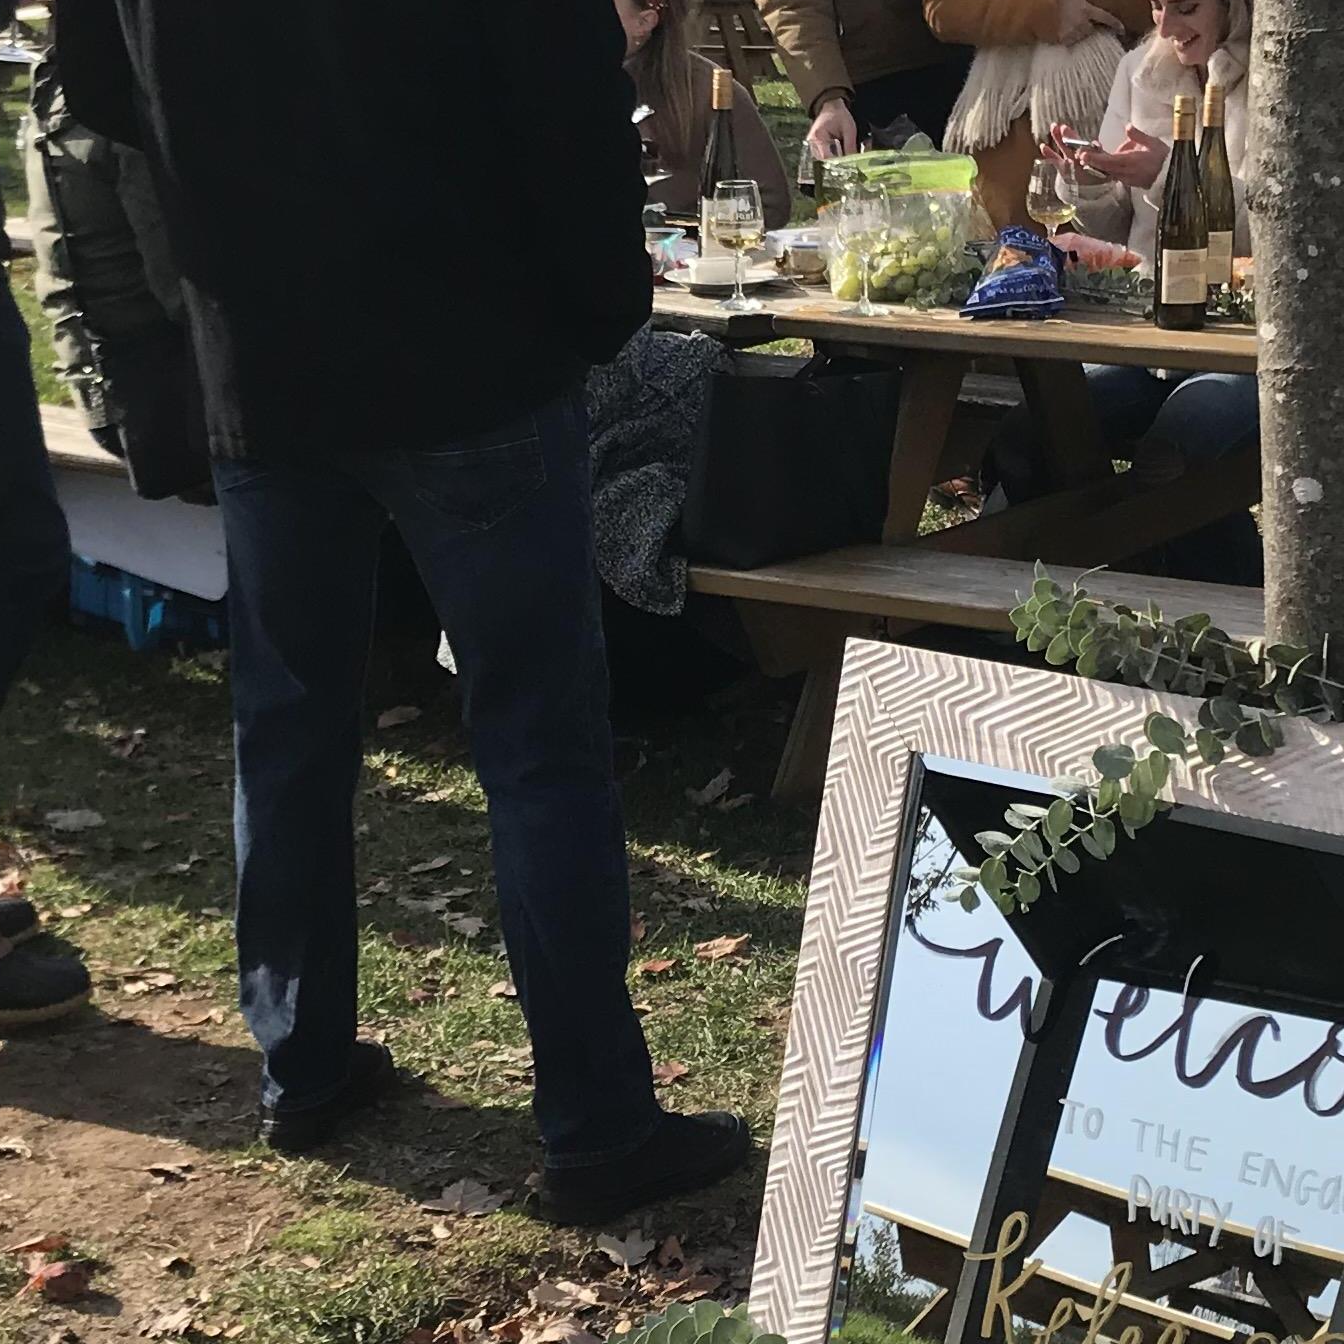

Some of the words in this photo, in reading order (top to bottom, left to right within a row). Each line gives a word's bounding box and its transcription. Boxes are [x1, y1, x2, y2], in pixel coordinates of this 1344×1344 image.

[1059, 1098, 1105, 1140] TO
[1130, 1117, 1212, 1173] THE
[1253, 1215, 1301, 1267] OF
